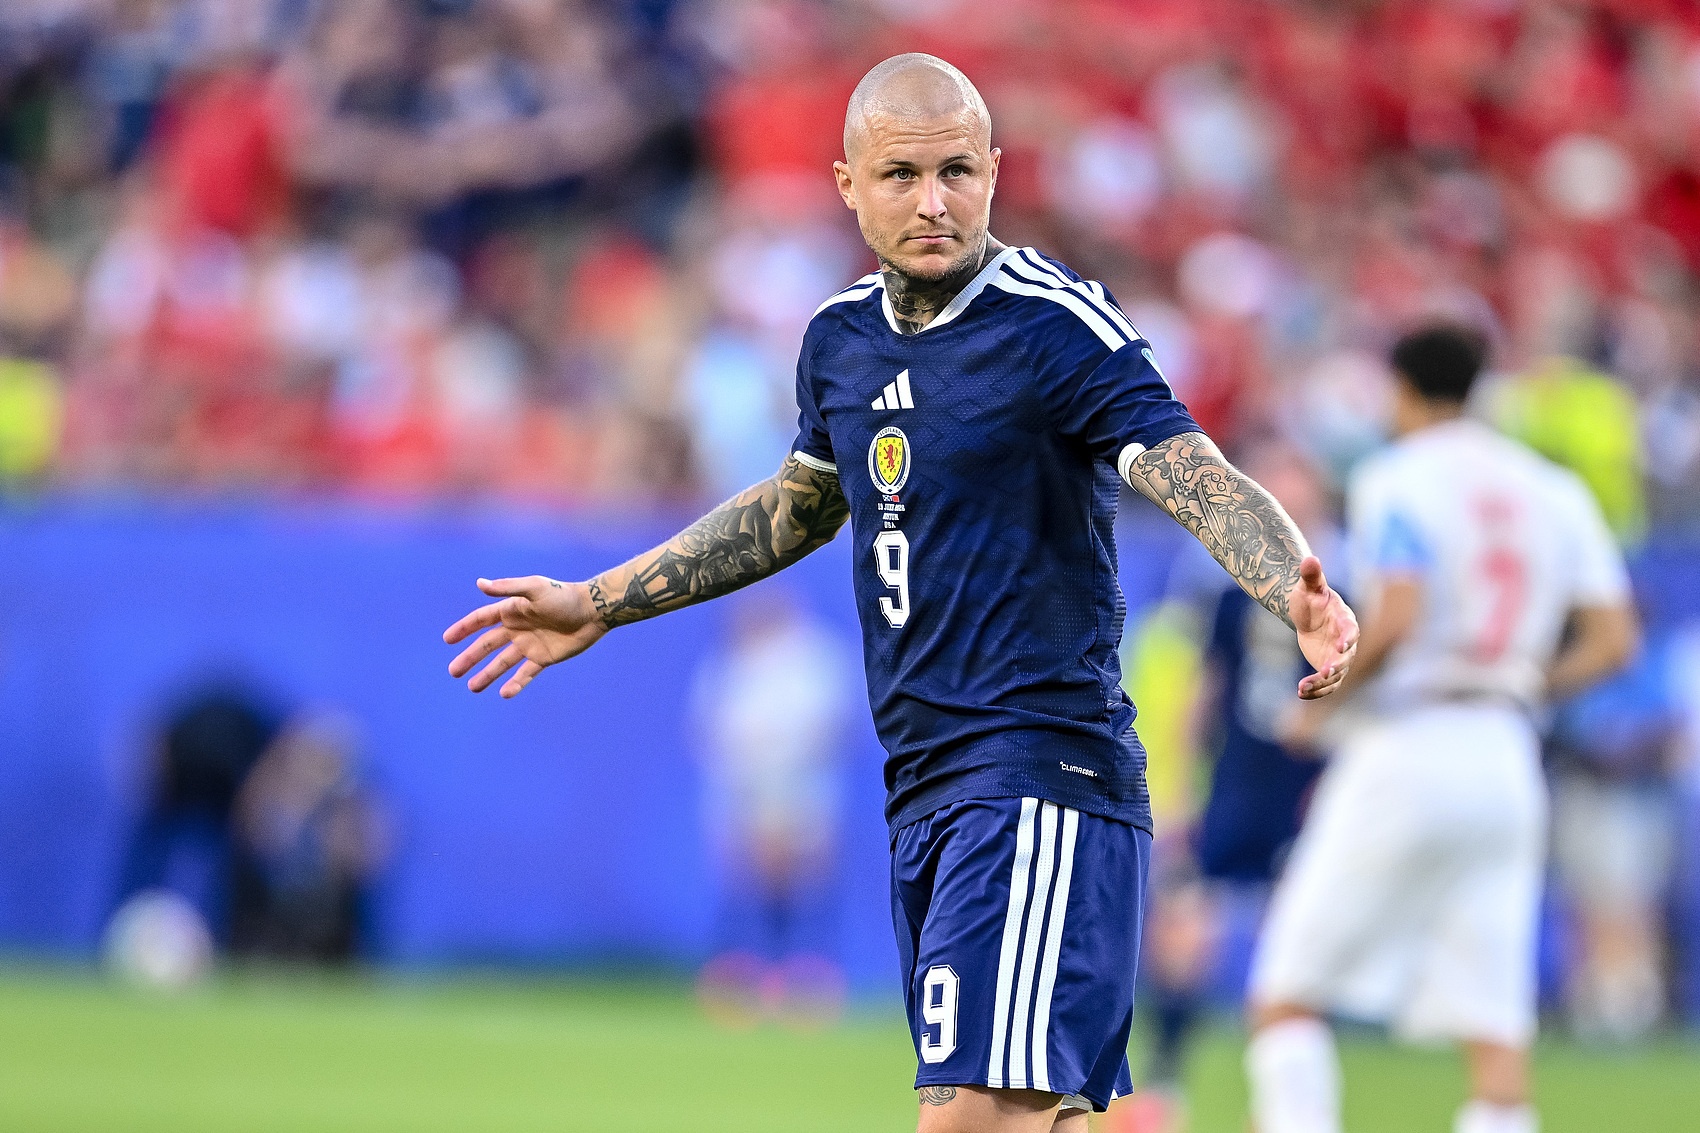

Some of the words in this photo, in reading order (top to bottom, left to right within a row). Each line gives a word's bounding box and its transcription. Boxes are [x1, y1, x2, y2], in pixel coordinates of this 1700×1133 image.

[879, 427, 902, 437] SCOTLAND
[873, 530, 910, 628] 9
[921, 964, 960, 1064] 9
